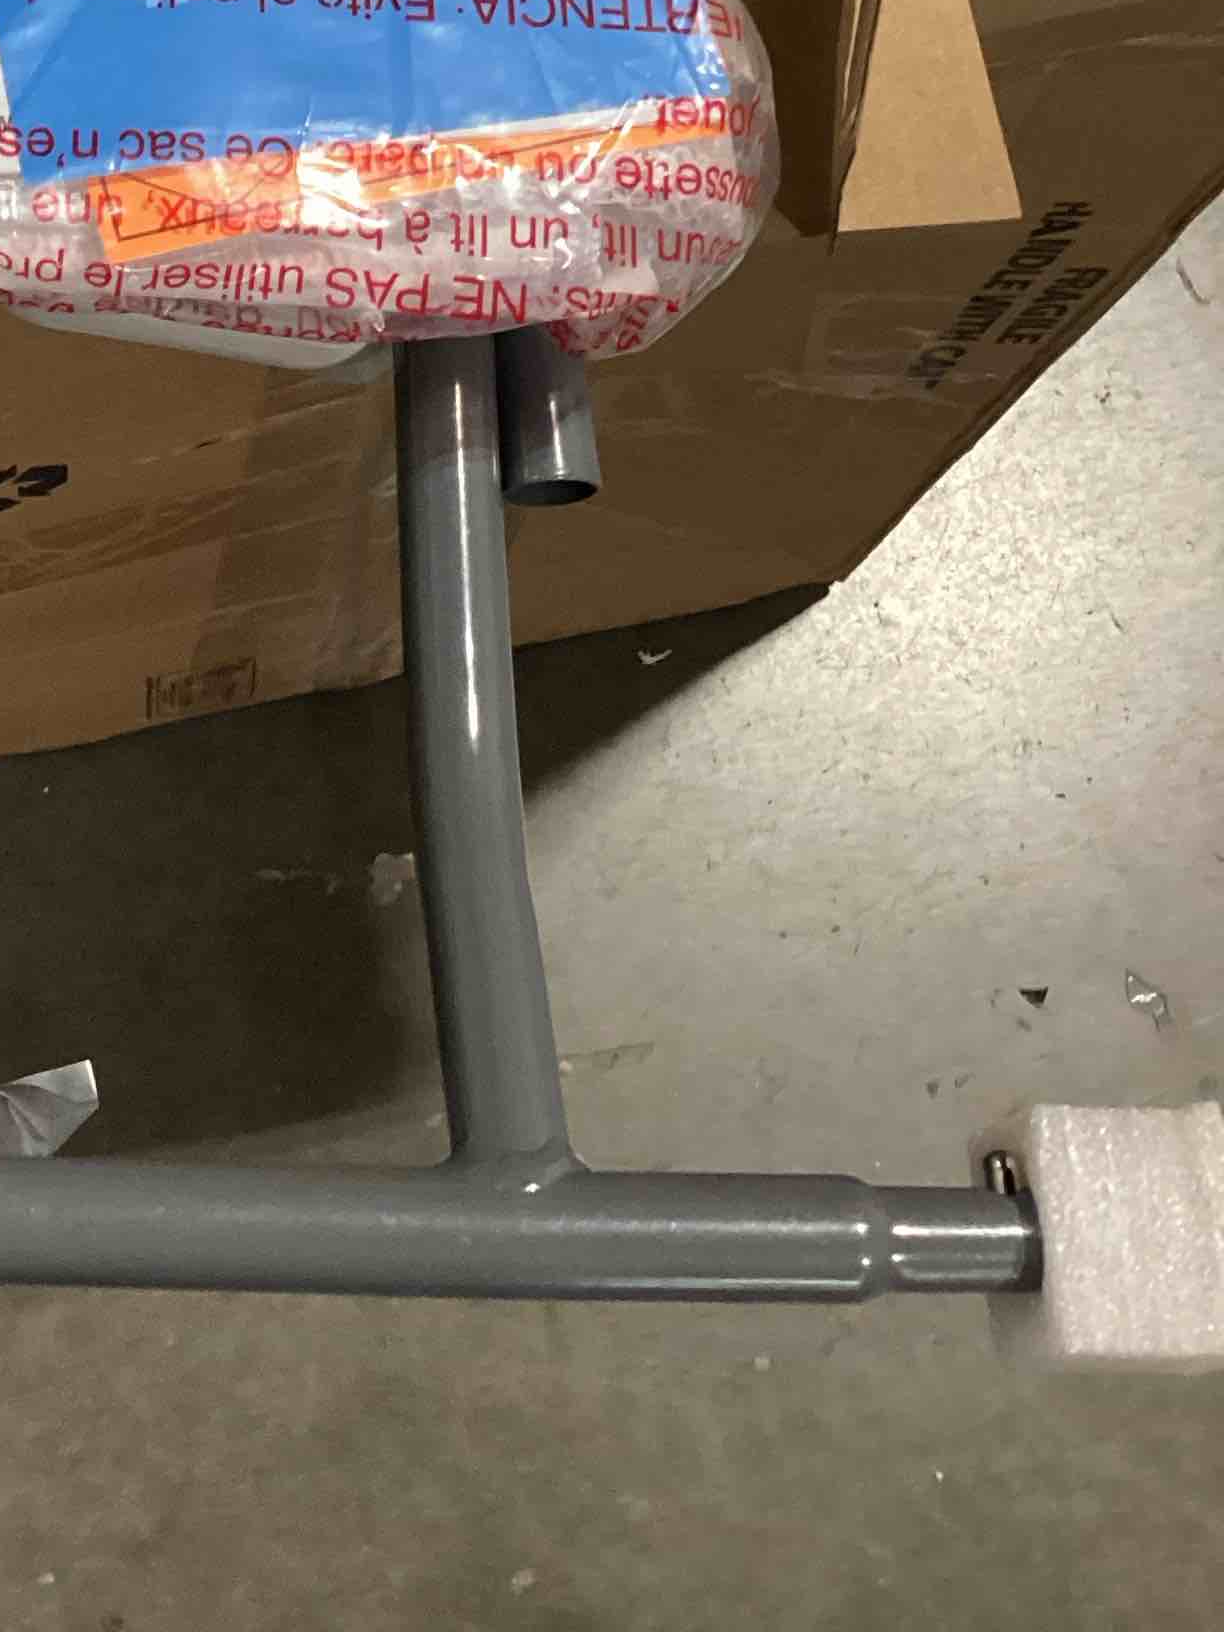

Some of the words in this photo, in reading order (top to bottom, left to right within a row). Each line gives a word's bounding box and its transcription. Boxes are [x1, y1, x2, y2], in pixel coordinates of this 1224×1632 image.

[119, 130, 206, 165] sac
[226, 135, 293, 177] Ce
[615, 157, 754, 209] oussette
[31, 191, 123, 227] une
[404, 211, 431, 254] à
[450, 214, 487, 257] lit
[510, 216, 569, 249] un
[592, 215, 638, 268] lit,
[84, 262, 128, 296] le
[142, 261, 303, 301] utiliser
[326, 268, 431, 313] PAS
[453, 277, 526, 323] NE
